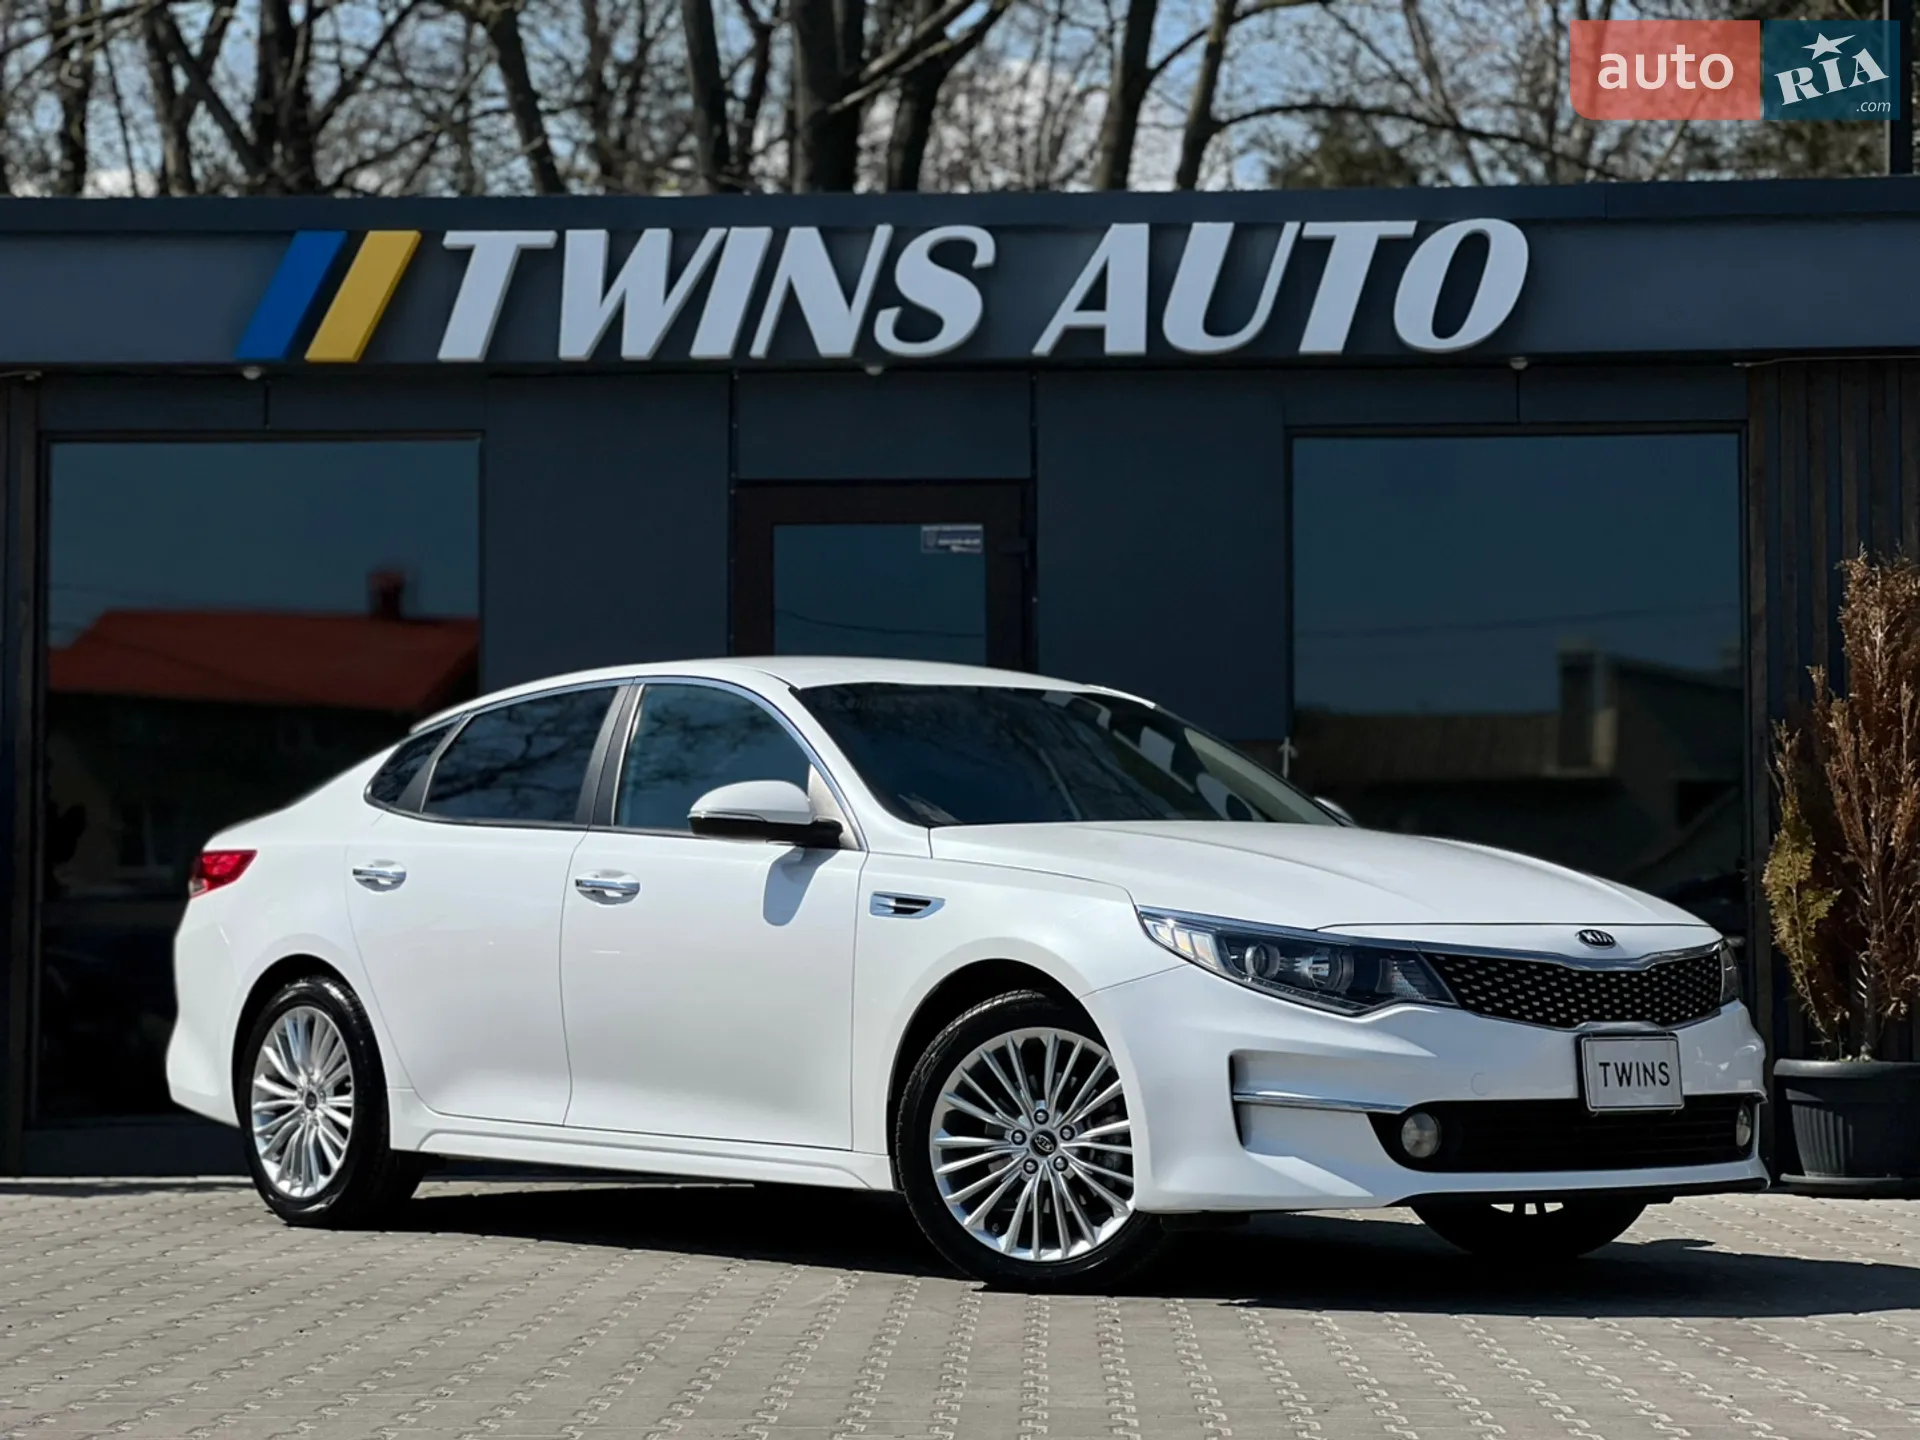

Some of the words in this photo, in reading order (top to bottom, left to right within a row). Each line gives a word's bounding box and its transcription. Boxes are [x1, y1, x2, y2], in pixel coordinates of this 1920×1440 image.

[437, 223, 997, 363] TWINS
[1031, 217, 1530, 356] AUTO
[1581, 931, 1613, 943] KIA
[1599, 1062, 1670, 1087] TWINS
